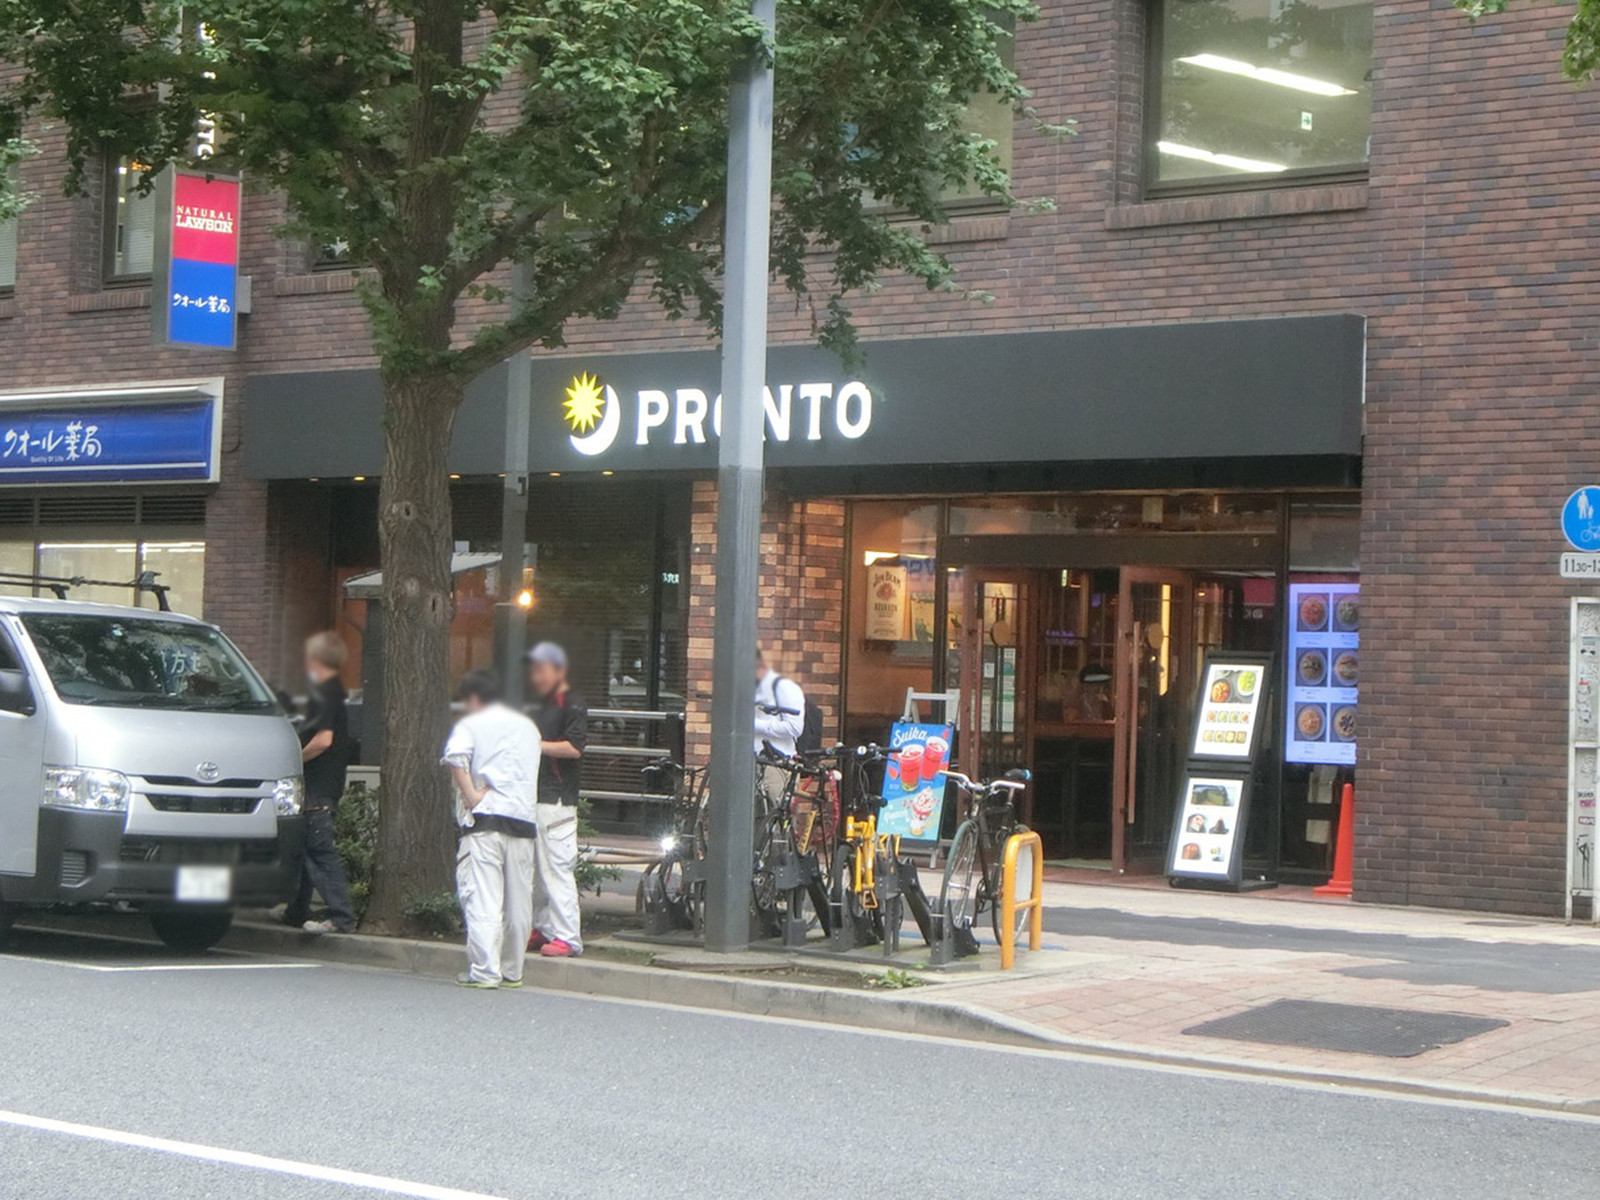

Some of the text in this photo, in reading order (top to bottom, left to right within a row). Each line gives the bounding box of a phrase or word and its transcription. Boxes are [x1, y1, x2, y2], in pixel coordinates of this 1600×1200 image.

[176, 205, 233, 221] NATURAL
[175, 214, 233, 234] LAWSON
[635, 381, 872, 445] PRNTO
[3, 420, 102, 461] クオール薬局
[892, 726, 928, 747] Suika
